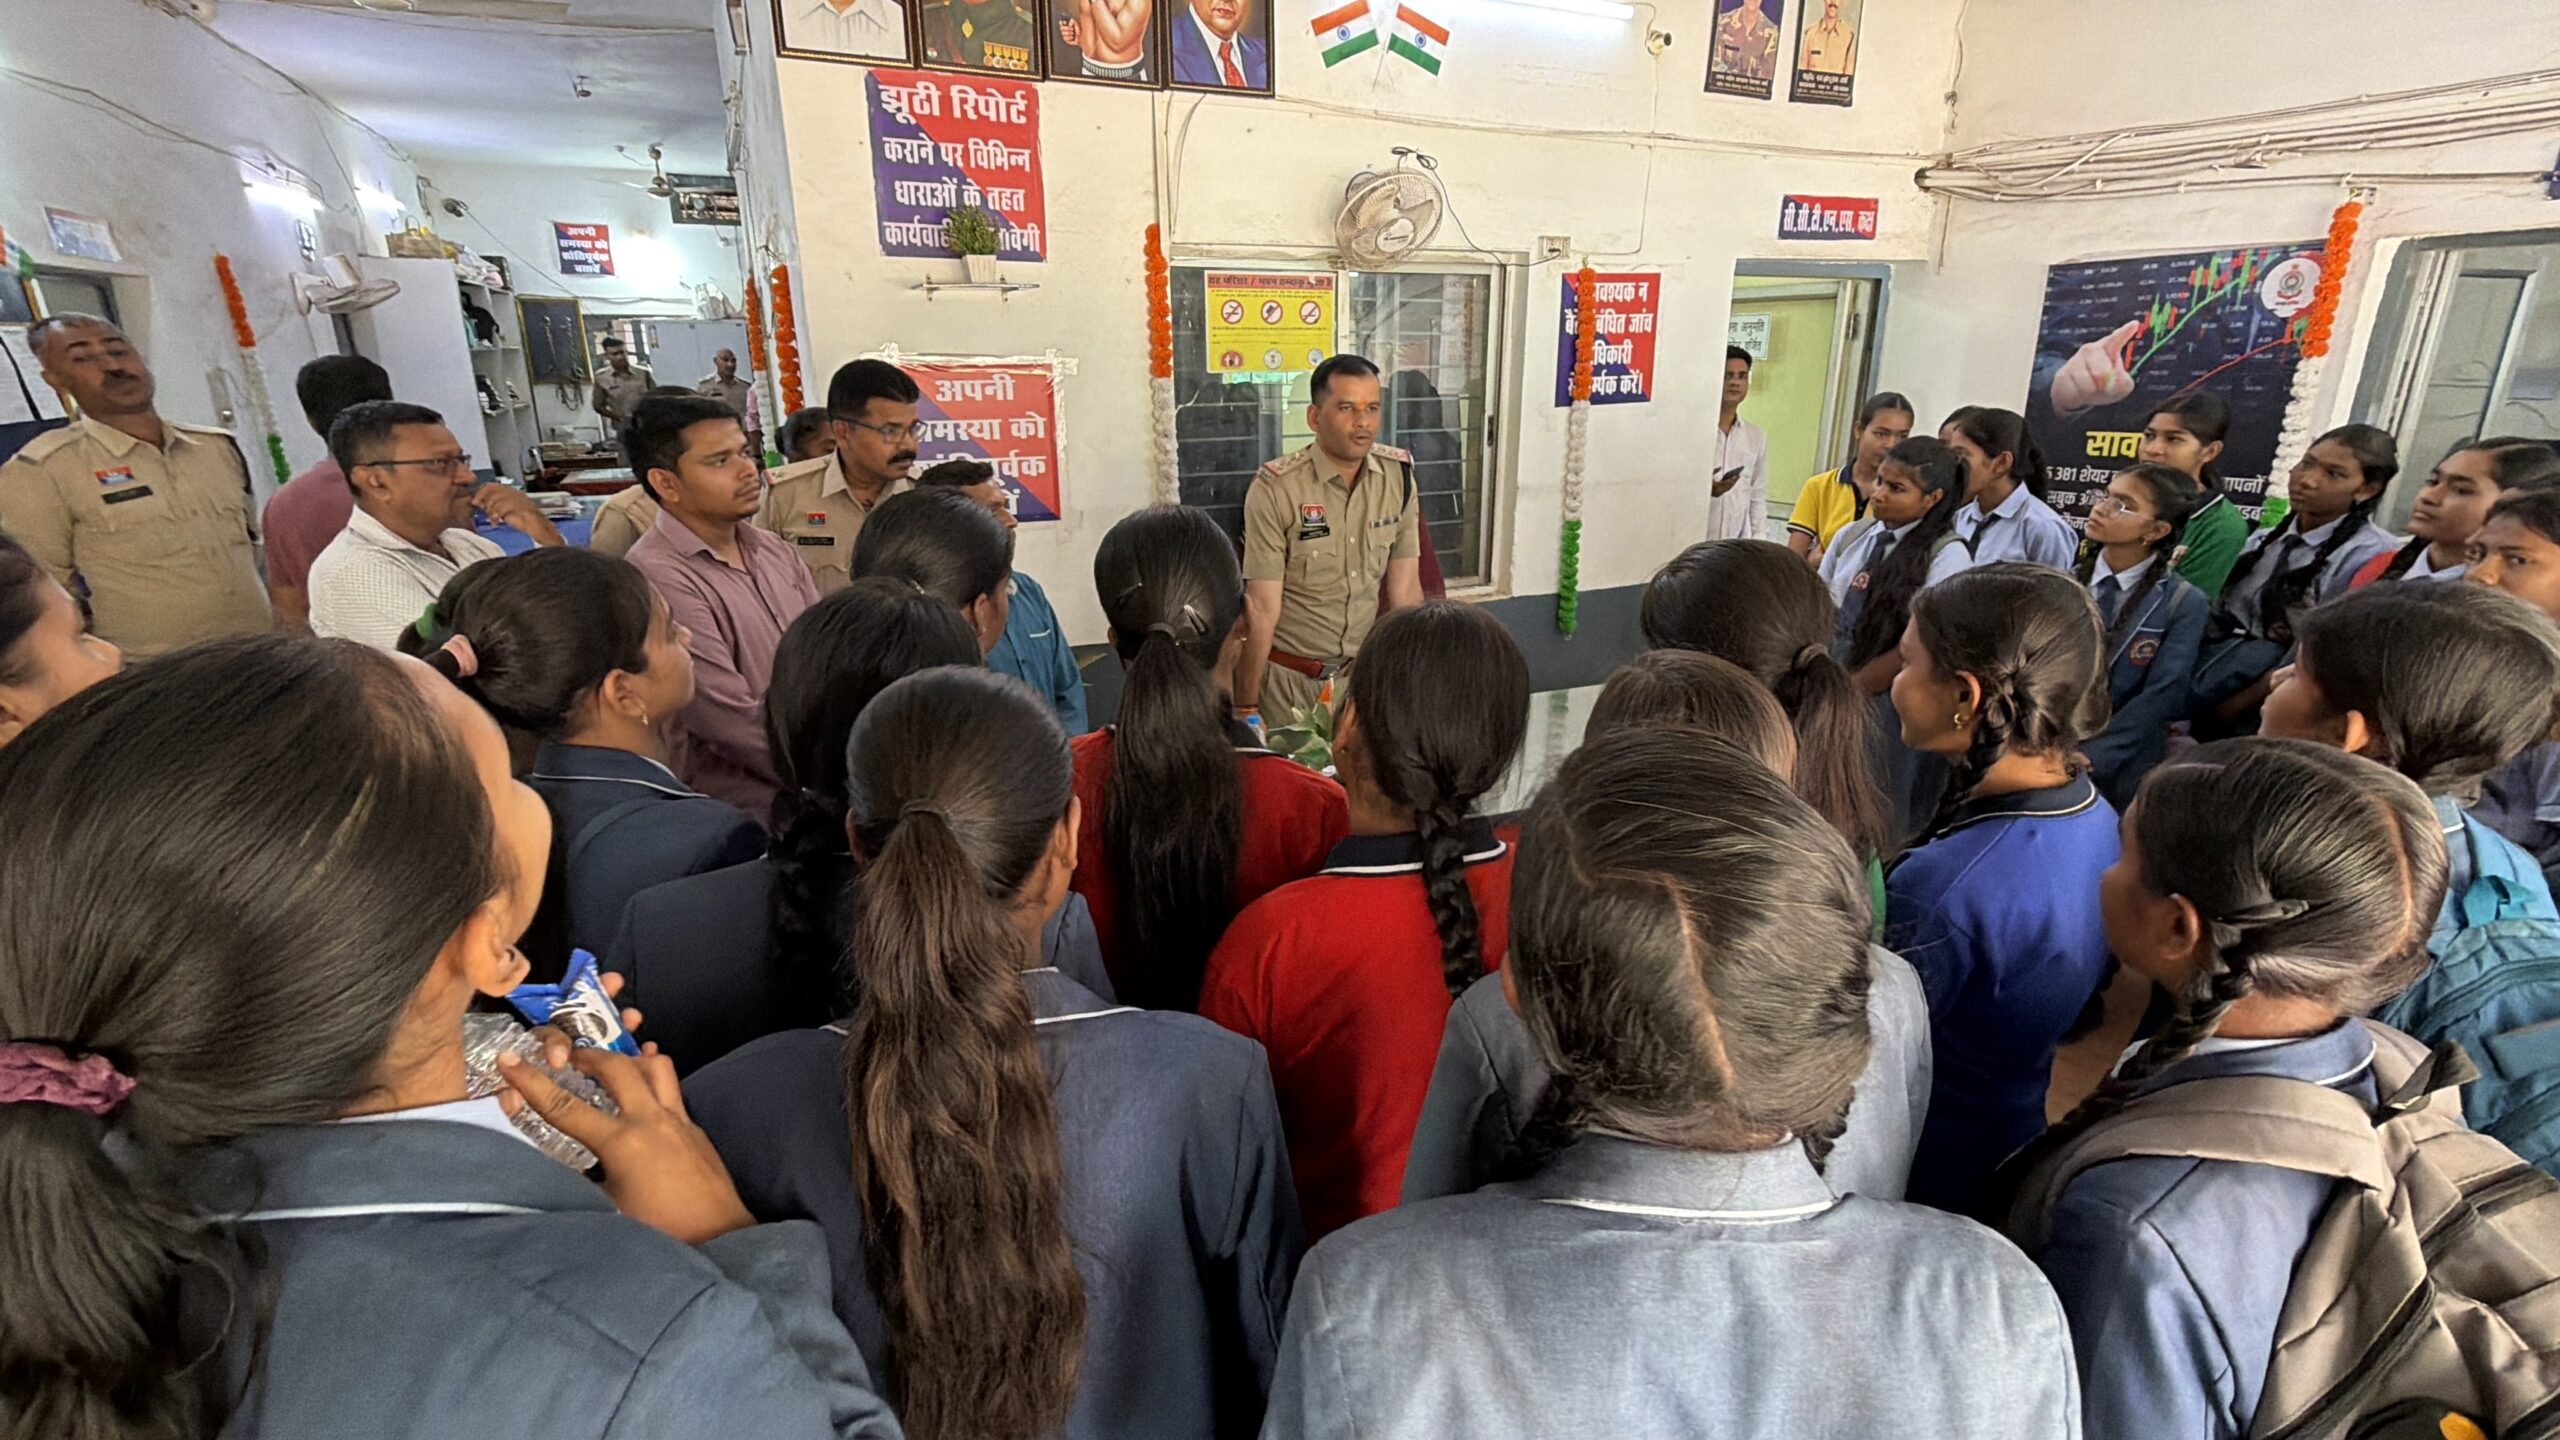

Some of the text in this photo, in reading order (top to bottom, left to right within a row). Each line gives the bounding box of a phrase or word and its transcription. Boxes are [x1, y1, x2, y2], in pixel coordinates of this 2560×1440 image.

[878, 81, 1028, 125] झूठी रिपोर्ट
[882, 133, 1031, 172] कराने पर विभिन्न
[894, 176, 1025, 212] धाराओं के तहत
[567, 226, 596, 237] अपनी
[1638, 282, 1649, 302] न
[1628, 308, 1654, 333] जांच
[1590, 339, 1633, 366] धिकारी
[935, 373, 1016, 402] अपनी
[1009, 411, 1047, 439] को
[2055, 466, 2077, 481] 381
[2079, 465, 2110, 483] शेयर
